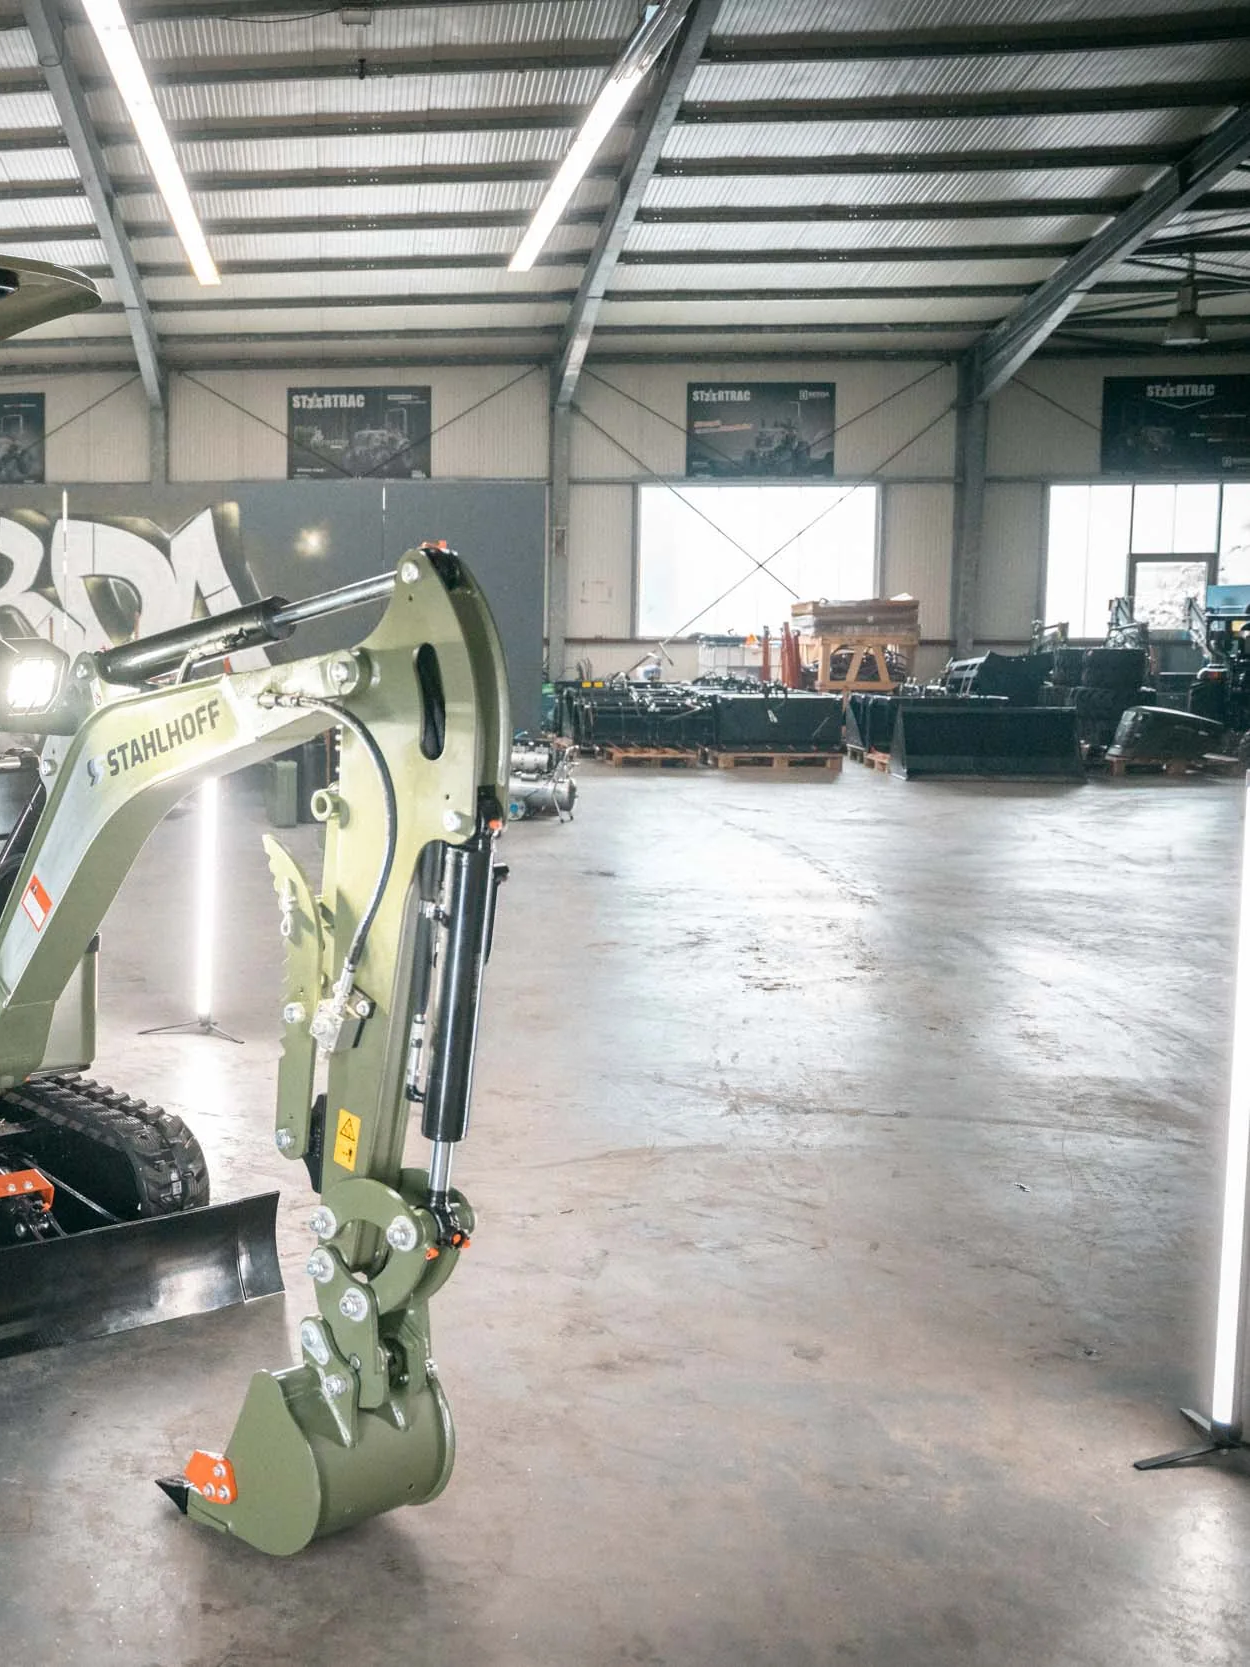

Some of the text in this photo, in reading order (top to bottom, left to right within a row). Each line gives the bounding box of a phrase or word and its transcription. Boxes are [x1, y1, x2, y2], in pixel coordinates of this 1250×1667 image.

[292, 392, 365, 409] STARTRAC
[692, 388, 751, 402] STARTRAC
[107, 698, 220, 777] STAHLHOFF
